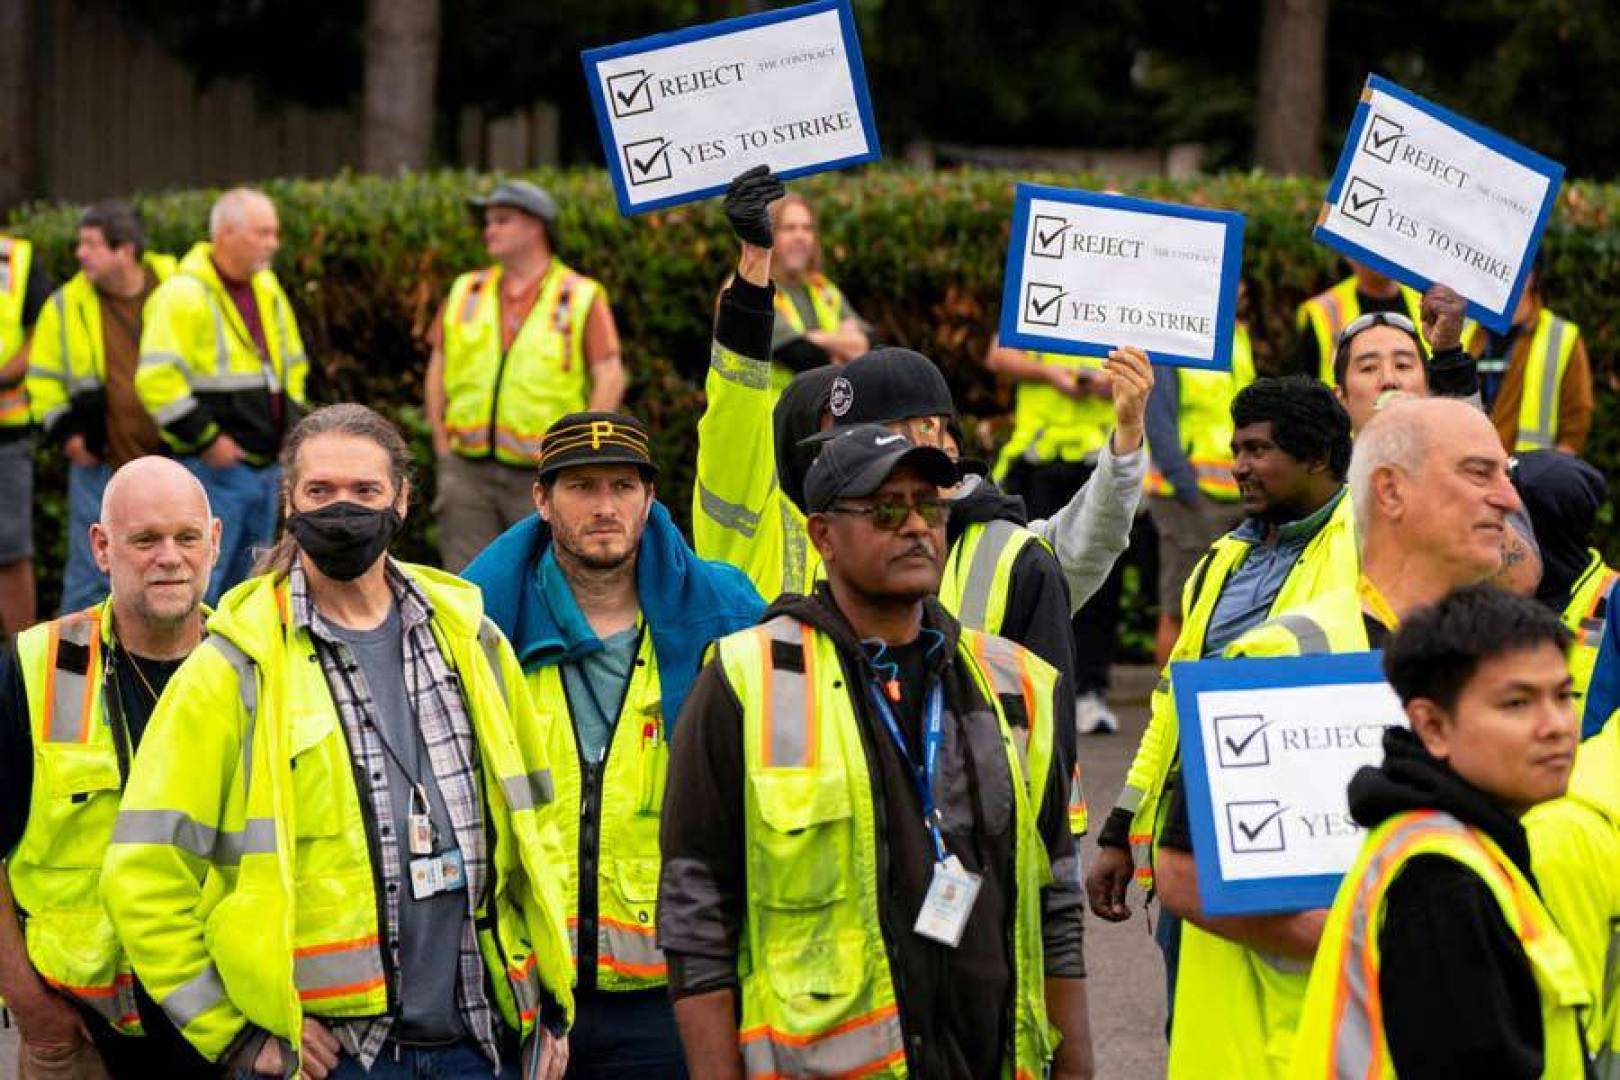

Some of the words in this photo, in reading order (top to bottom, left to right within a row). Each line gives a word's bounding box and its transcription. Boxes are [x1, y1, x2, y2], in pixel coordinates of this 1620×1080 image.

[658, 62, 745, 99] REJECT
[680, 139, 727, 166] YES
[736, 131, 769, 152] TO
[772, 111, 853, 143] STRIKE
[1401, 144, 1470, 190] REJECT
[1072, 233, 1144, 259] REJECT
[1385, 208, 1419, 239] YES
[1427, 228, 1451, 251] TO
[1454, 244, 1512, 284] STRIKE
[1072, 301, 1107, 324] YES
[1118, 306, 1143, 325] TO
[1147, 311, 1211, 335] STRIKE
[591, 421, 613, 450] P
